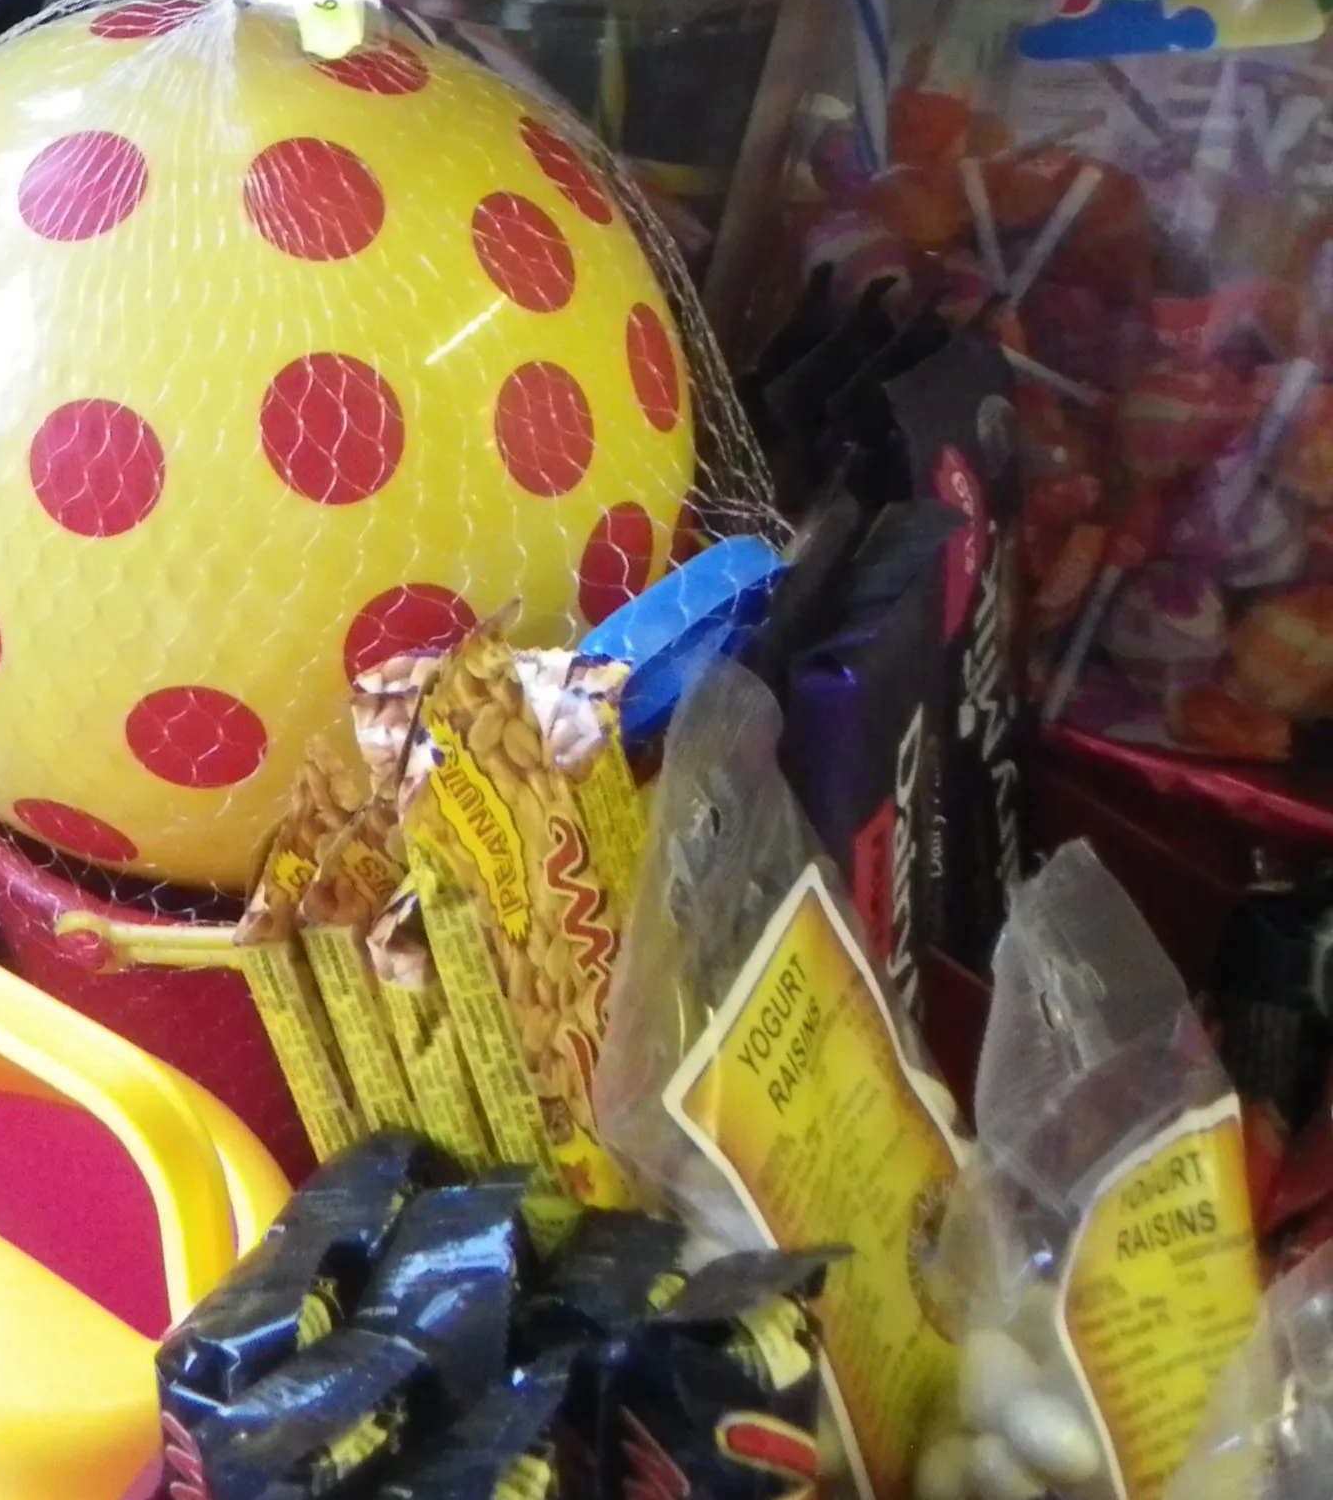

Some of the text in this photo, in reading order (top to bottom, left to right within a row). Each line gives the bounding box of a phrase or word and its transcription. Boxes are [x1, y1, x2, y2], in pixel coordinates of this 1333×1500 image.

[737, 952, 808, 1077] YOGURT
[766, 995, 822, 1117] RAISINS
[1116, 1199, 1218, 1263] RAISINS
